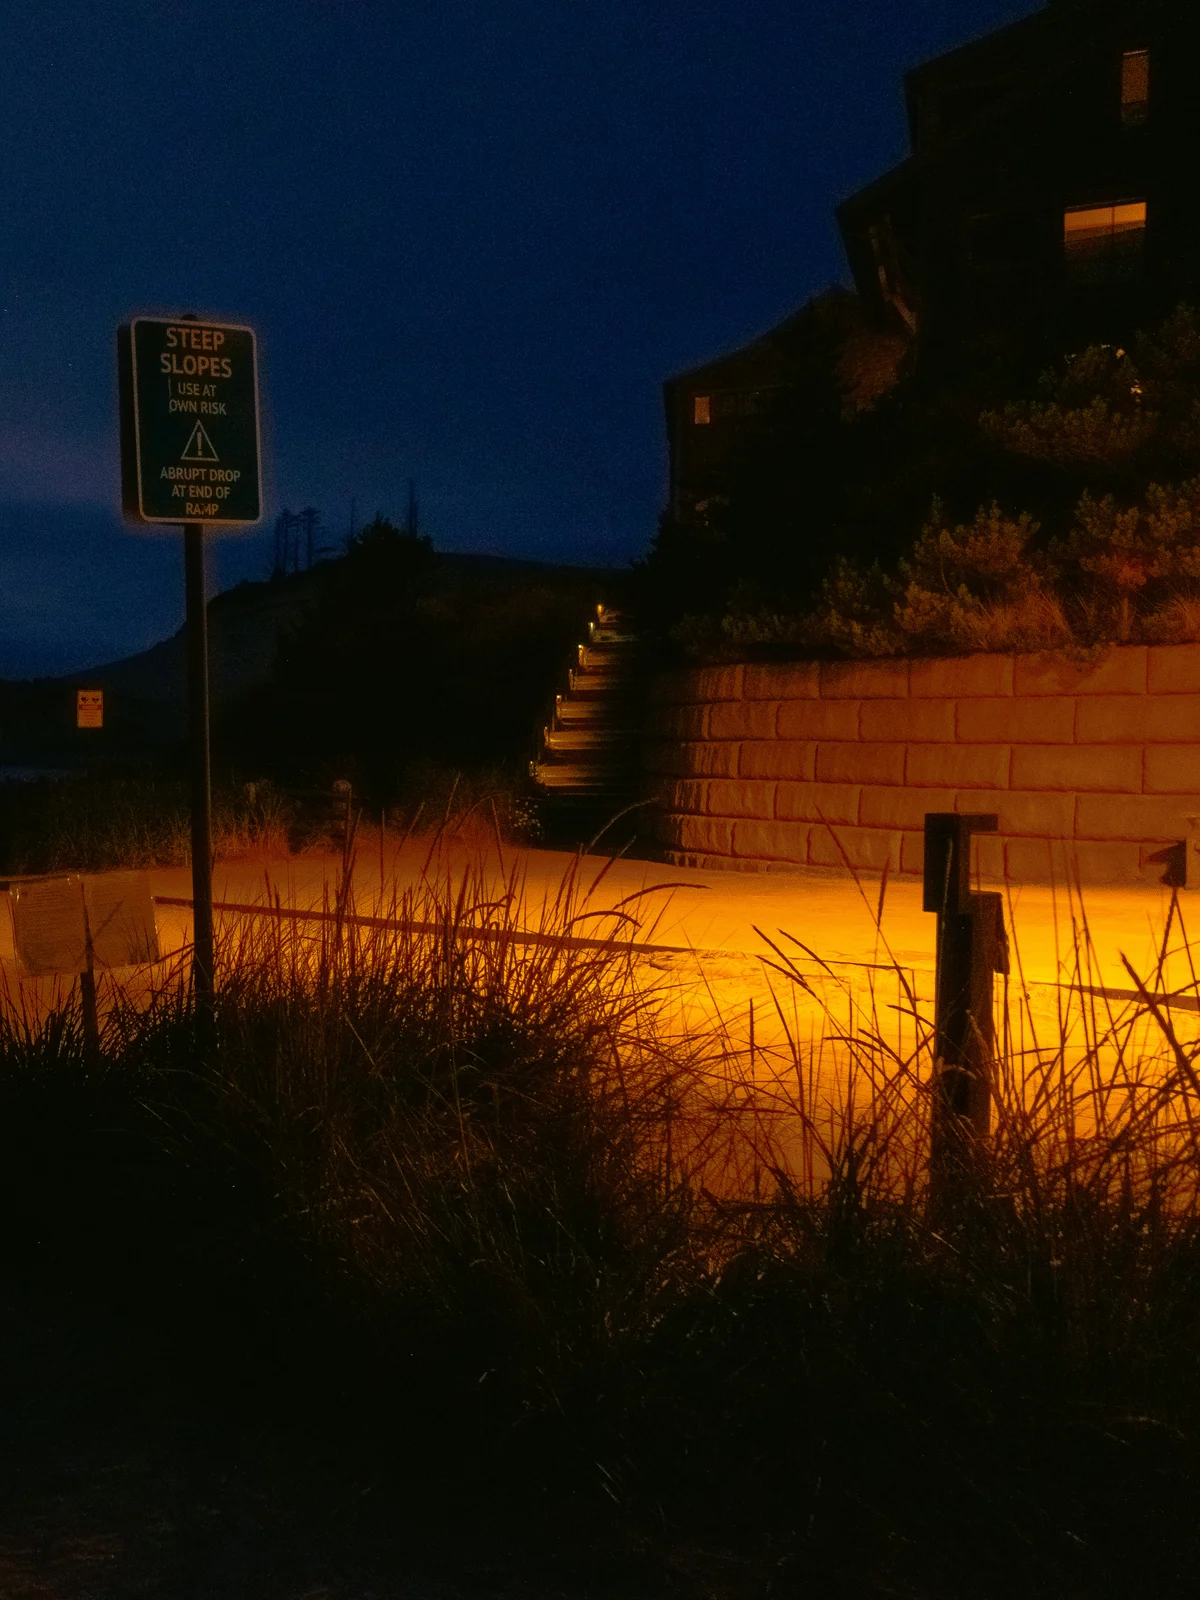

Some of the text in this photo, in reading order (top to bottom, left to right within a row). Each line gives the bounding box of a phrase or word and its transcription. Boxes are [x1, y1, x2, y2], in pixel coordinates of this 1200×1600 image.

[166, 327, 225, 351] STEEP
[160, 353, 232, 378] SLOPES
[177, 383, 217, 397] USE AT
[169, 399, 227, 415] OWN RISK
[160, 467, 240, 482] ABRUPT DROP
[172, 485, 231, 499] AT END OF
